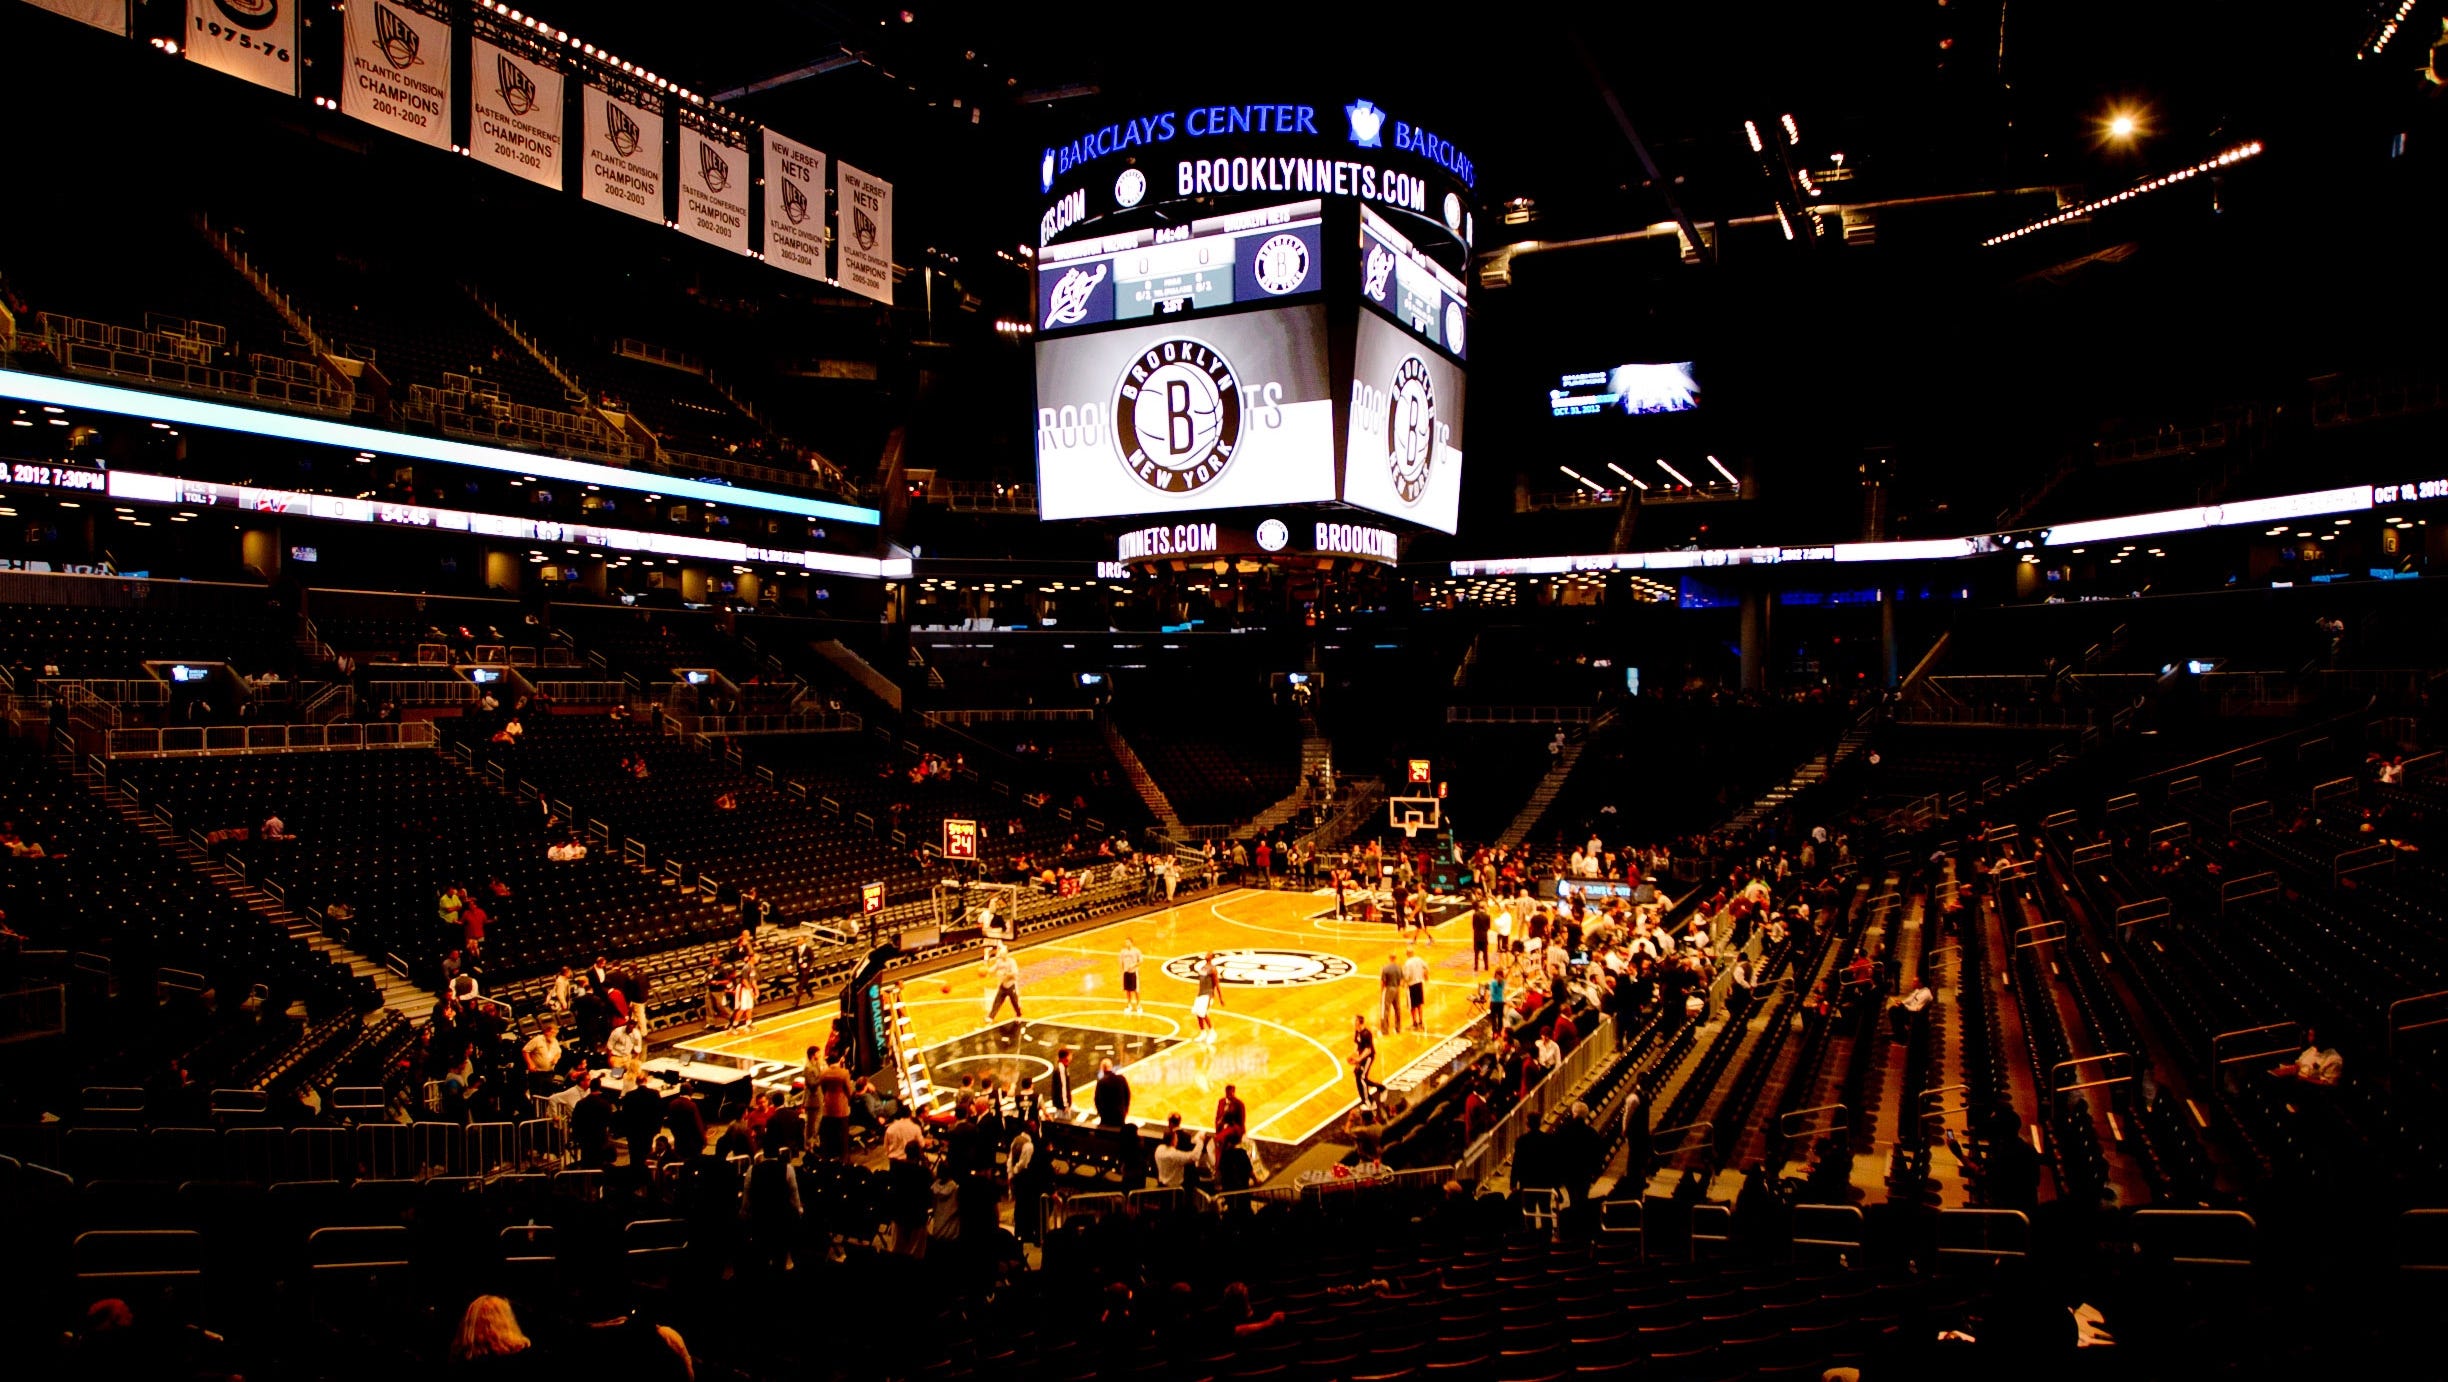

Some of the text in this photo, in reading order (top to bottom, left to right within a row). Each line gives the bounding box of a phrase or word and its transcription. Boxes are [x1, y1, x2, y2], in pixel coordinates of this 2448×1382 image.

[196, 17, 290, 62] 1975-76
[355, 57, 444, 99] ATLANTIC DIVISION
[359, 75, 439, 115] CHAMPIONS
[373, 99, 427, 127] 2001-2002
[475, 104, 510, 126] EASTERN
[483, 121, 552, 158] CHAMPIONS
[1059, 104, 1318, 174] BARCLAYS CENTER
[495, 143, 541, 169] 2001-2002
[591, 150, 658, 180] ATLANTIC DIVISION
[772, 141, 819, 169] NEW JERSEY
[1395, 121, 1475, 188] BARCLAYS
[595, 164, 655, 195] CHAMPIONS
[782, 159, 810, 183] NETS
[1178, 157, 1425, 212] BROOKLYNNETS.COM
[605, 184, 645, 206] 2002-2003
[845, 174, 886, 198] NEW JERSEY
[689, 200, 741, 228] CHAMPIONS
[710, 196, 746, 216] CONFERENCE
[854, 191, 879, 211] NETS
[697, 218, 732, 238] 2002-2003
[771, 220, 822, 244] ATLANTIC DIVISION
[773, 232, 819, 257] CHAMPIONS
[846, 258, 886, 281] CHAMPIONS
[1121, 342, 1234, 401] BROOKLYN
[1166, 379, 1194, 455] B
[14, 465, 50, 485] 2012
[53, 469, 105, 491] 7:30PM
[1129, 440, 1233, 489] NEW YORK
[209, 494, 217, 505] 7
[2375, 480, 2448, 504] OCT 19, 2012
[381, 504, 430, 526] 54:45
[951, 835, 971, 854] 24
[871, 999, 886, 1050] BARCLA
